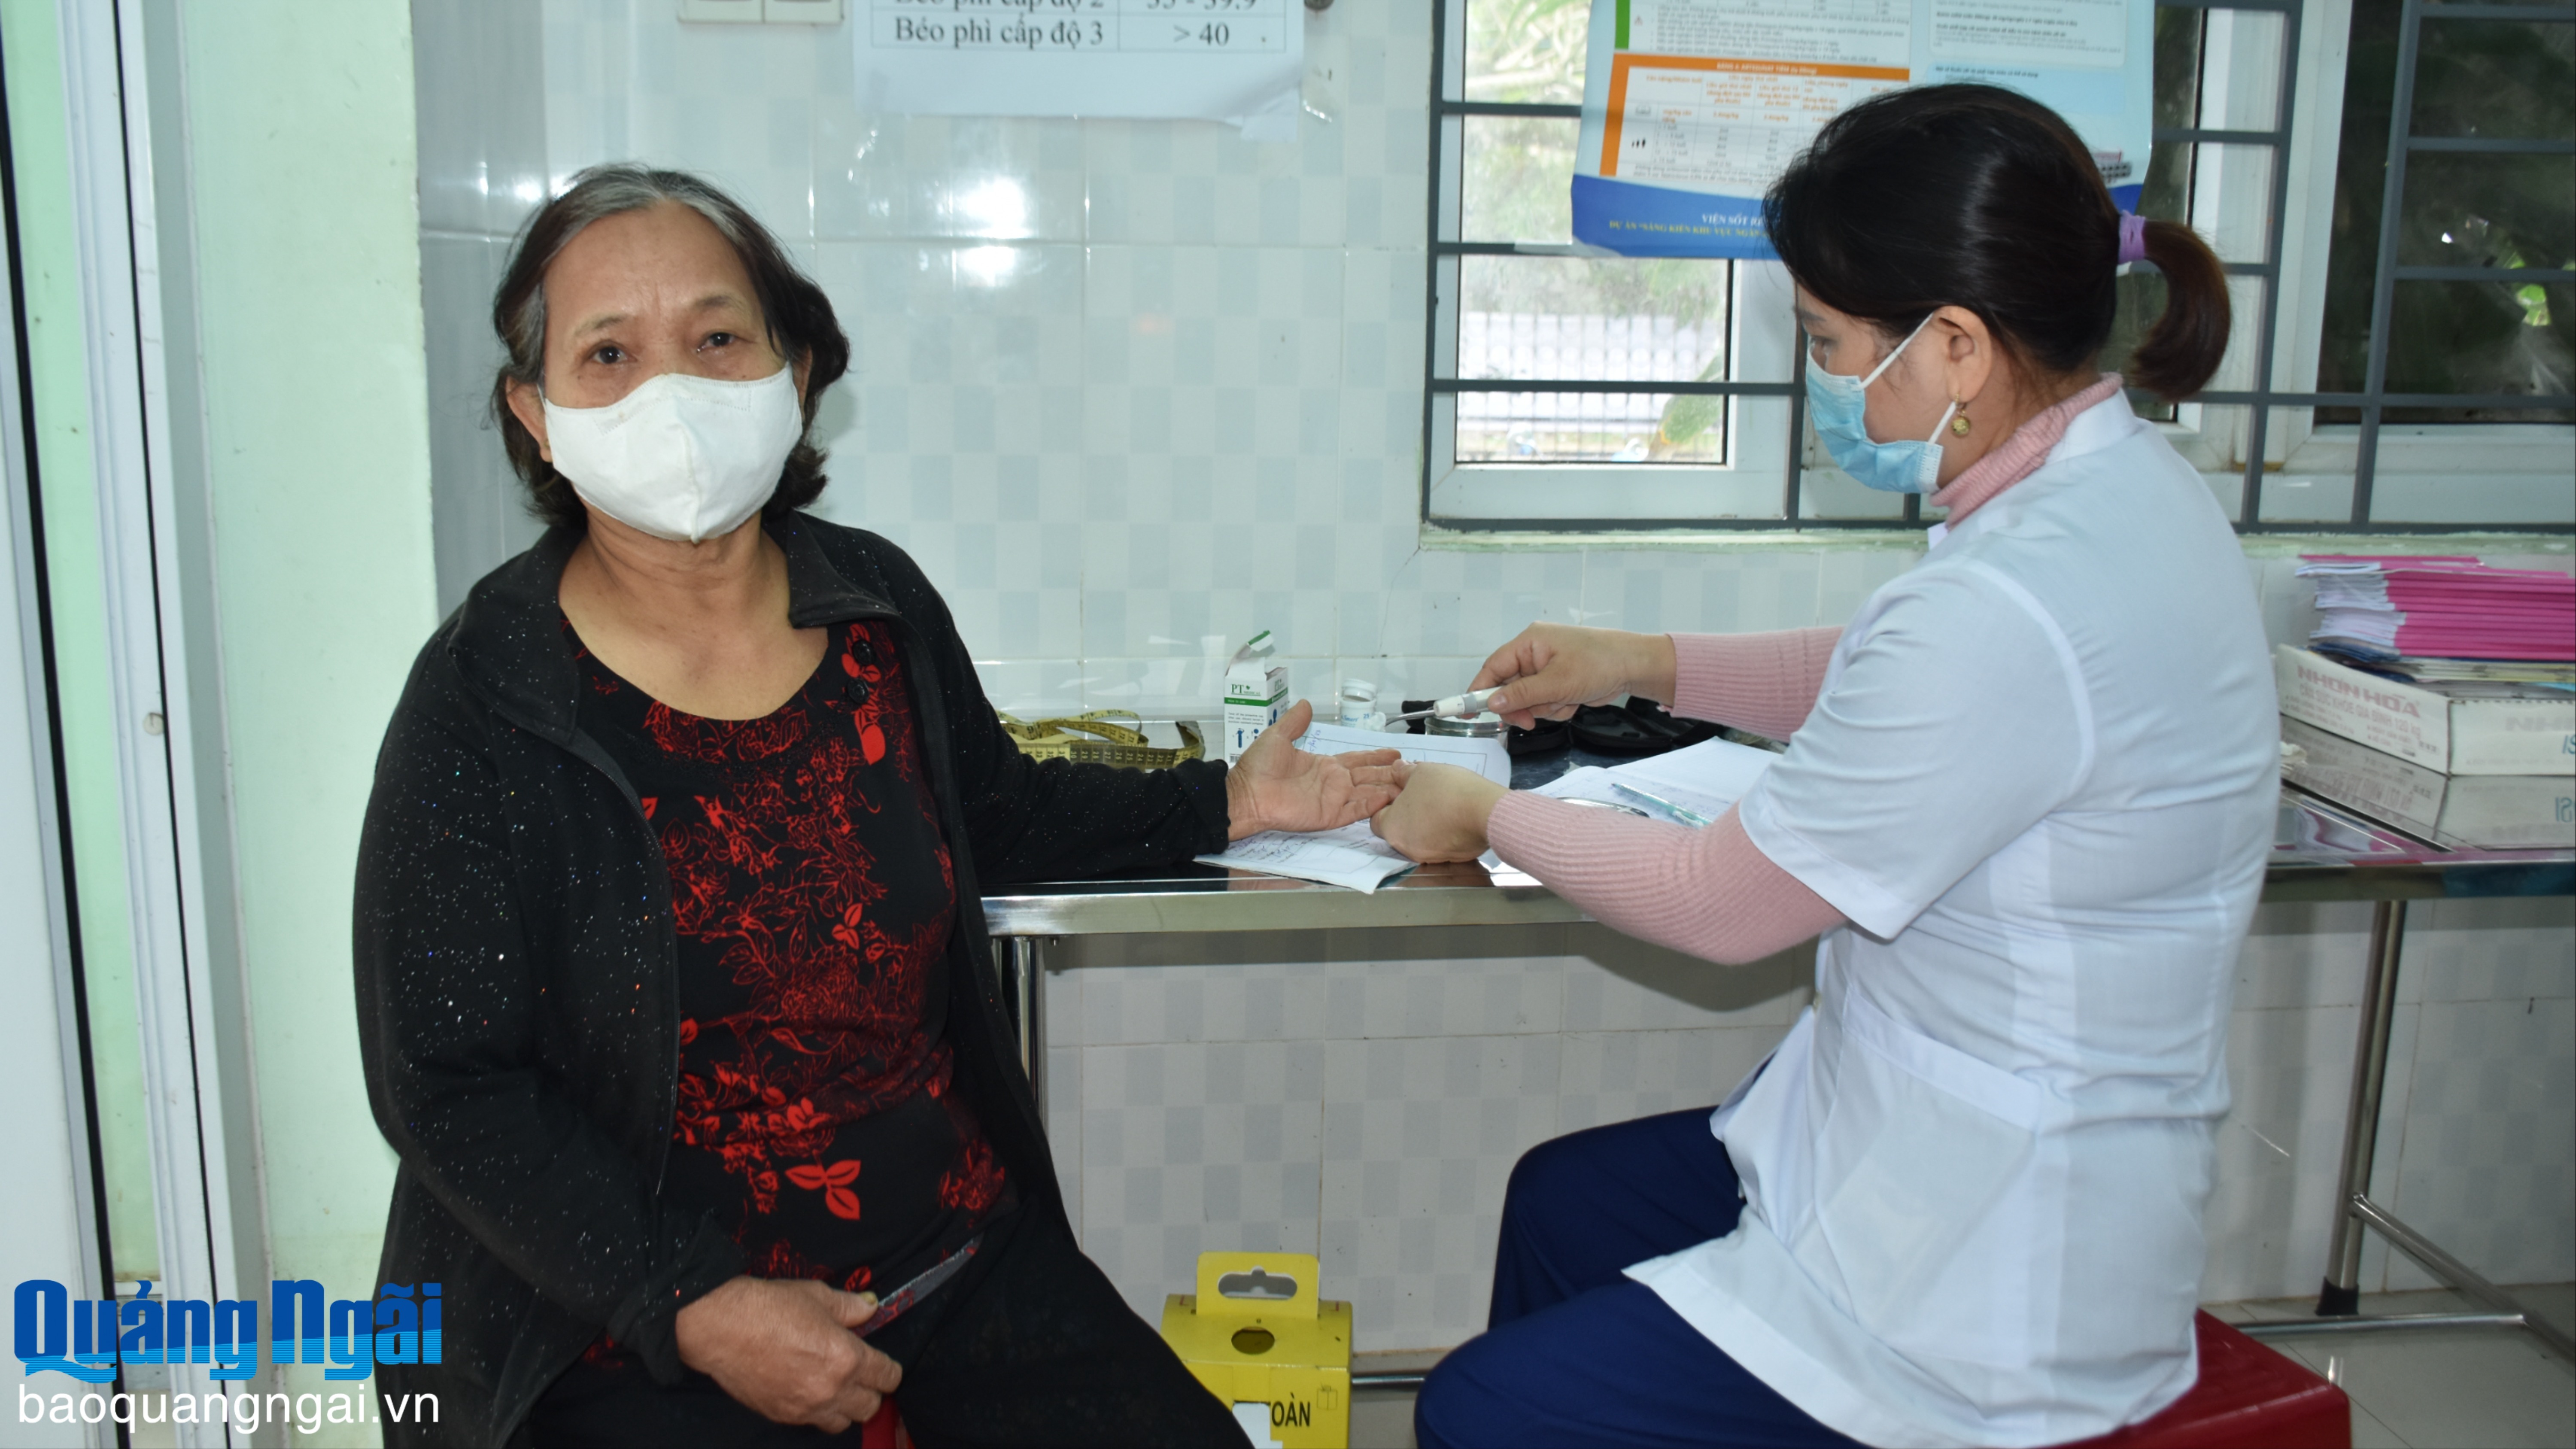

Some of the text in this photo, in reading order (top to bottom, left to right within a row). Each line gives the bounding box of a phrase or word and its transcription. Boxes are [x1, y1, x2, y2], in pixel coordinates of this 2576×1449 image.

[896, 12, 1103, 50] Béo phì cấp độ 3
[1199, 21, 1229, 46] 40
[1231, 684, 1244, 694] PT
[1271, 1392, 1311, 1427] OÀN
